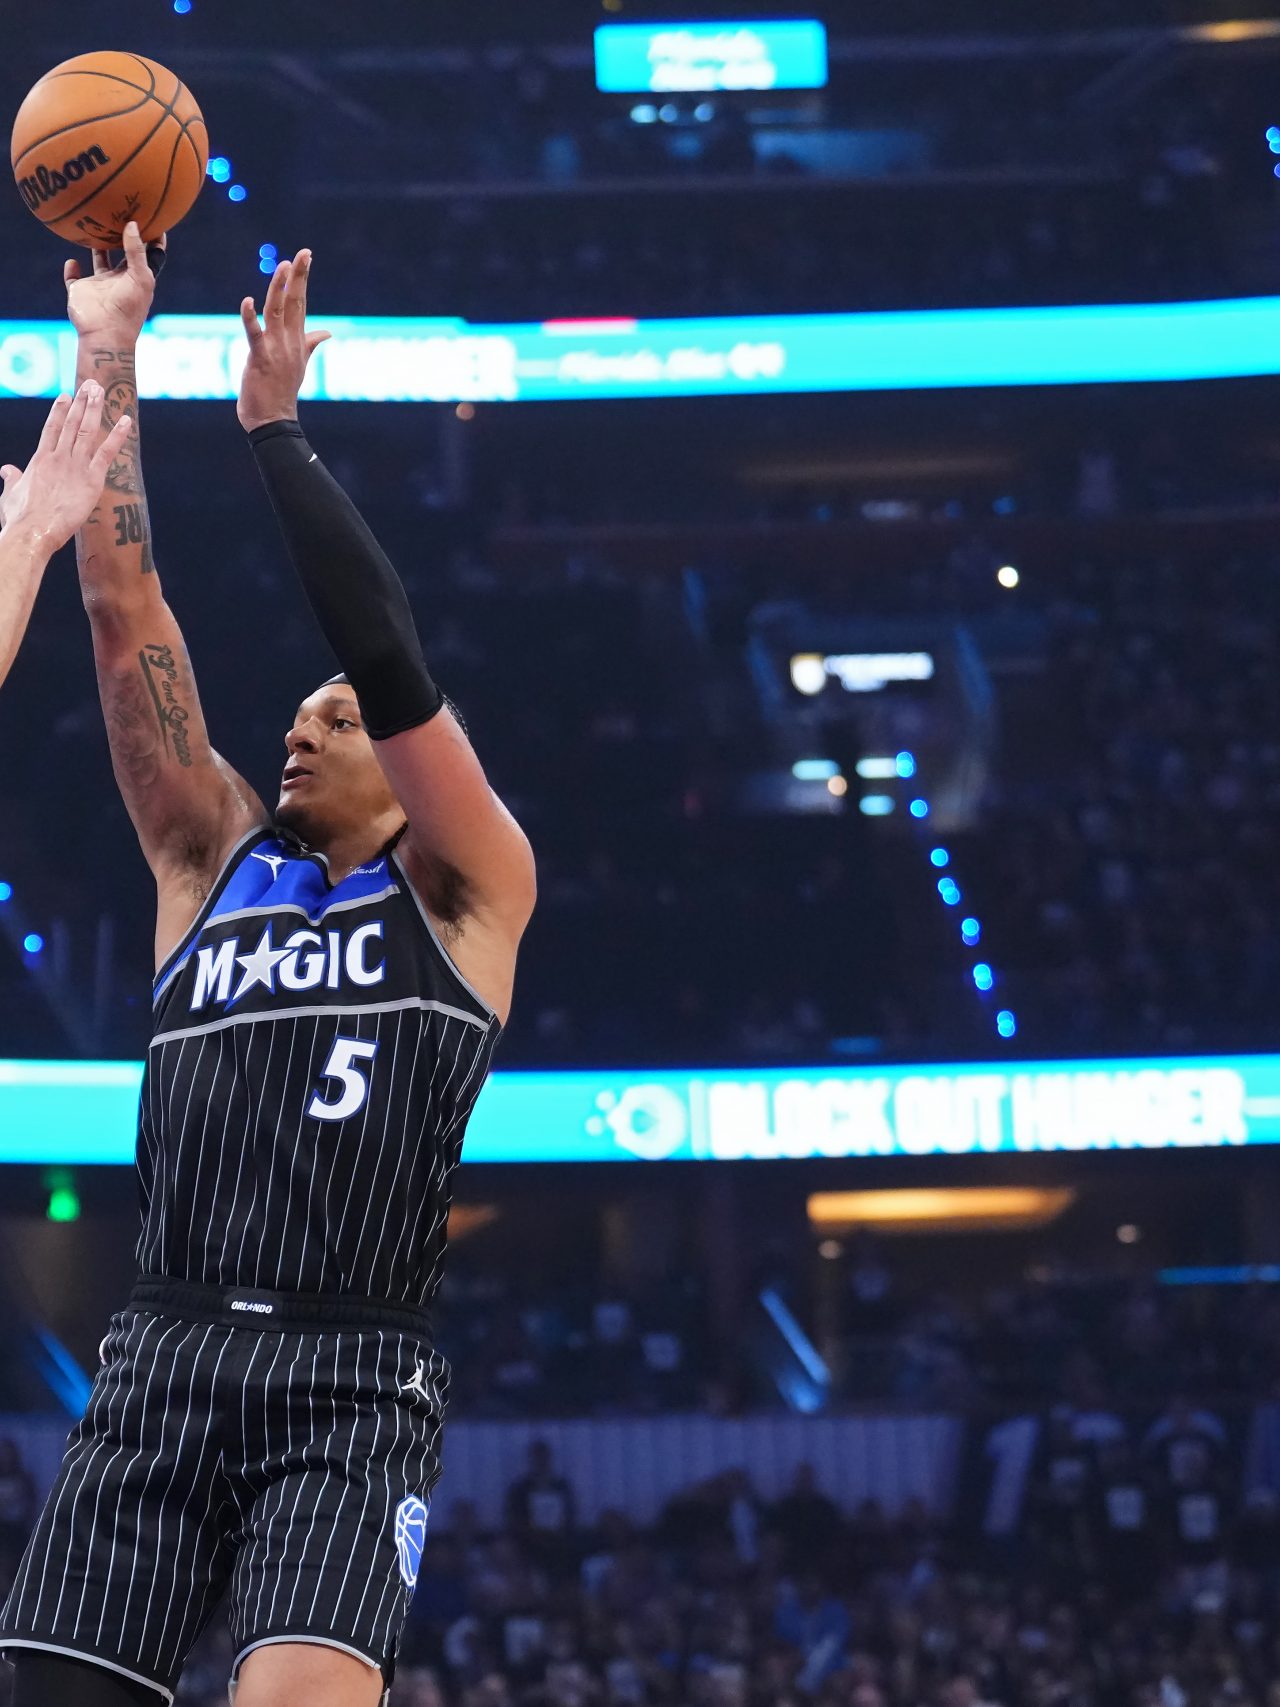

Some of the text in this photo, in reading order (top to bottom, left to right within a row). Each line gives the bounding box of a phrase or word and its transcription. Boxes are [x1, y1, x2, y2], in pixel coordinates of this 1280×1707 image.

[305, 1035, 379, 1123] 5
[709, 1069, 1247, 1158] BLOCK OUT HUNGER
